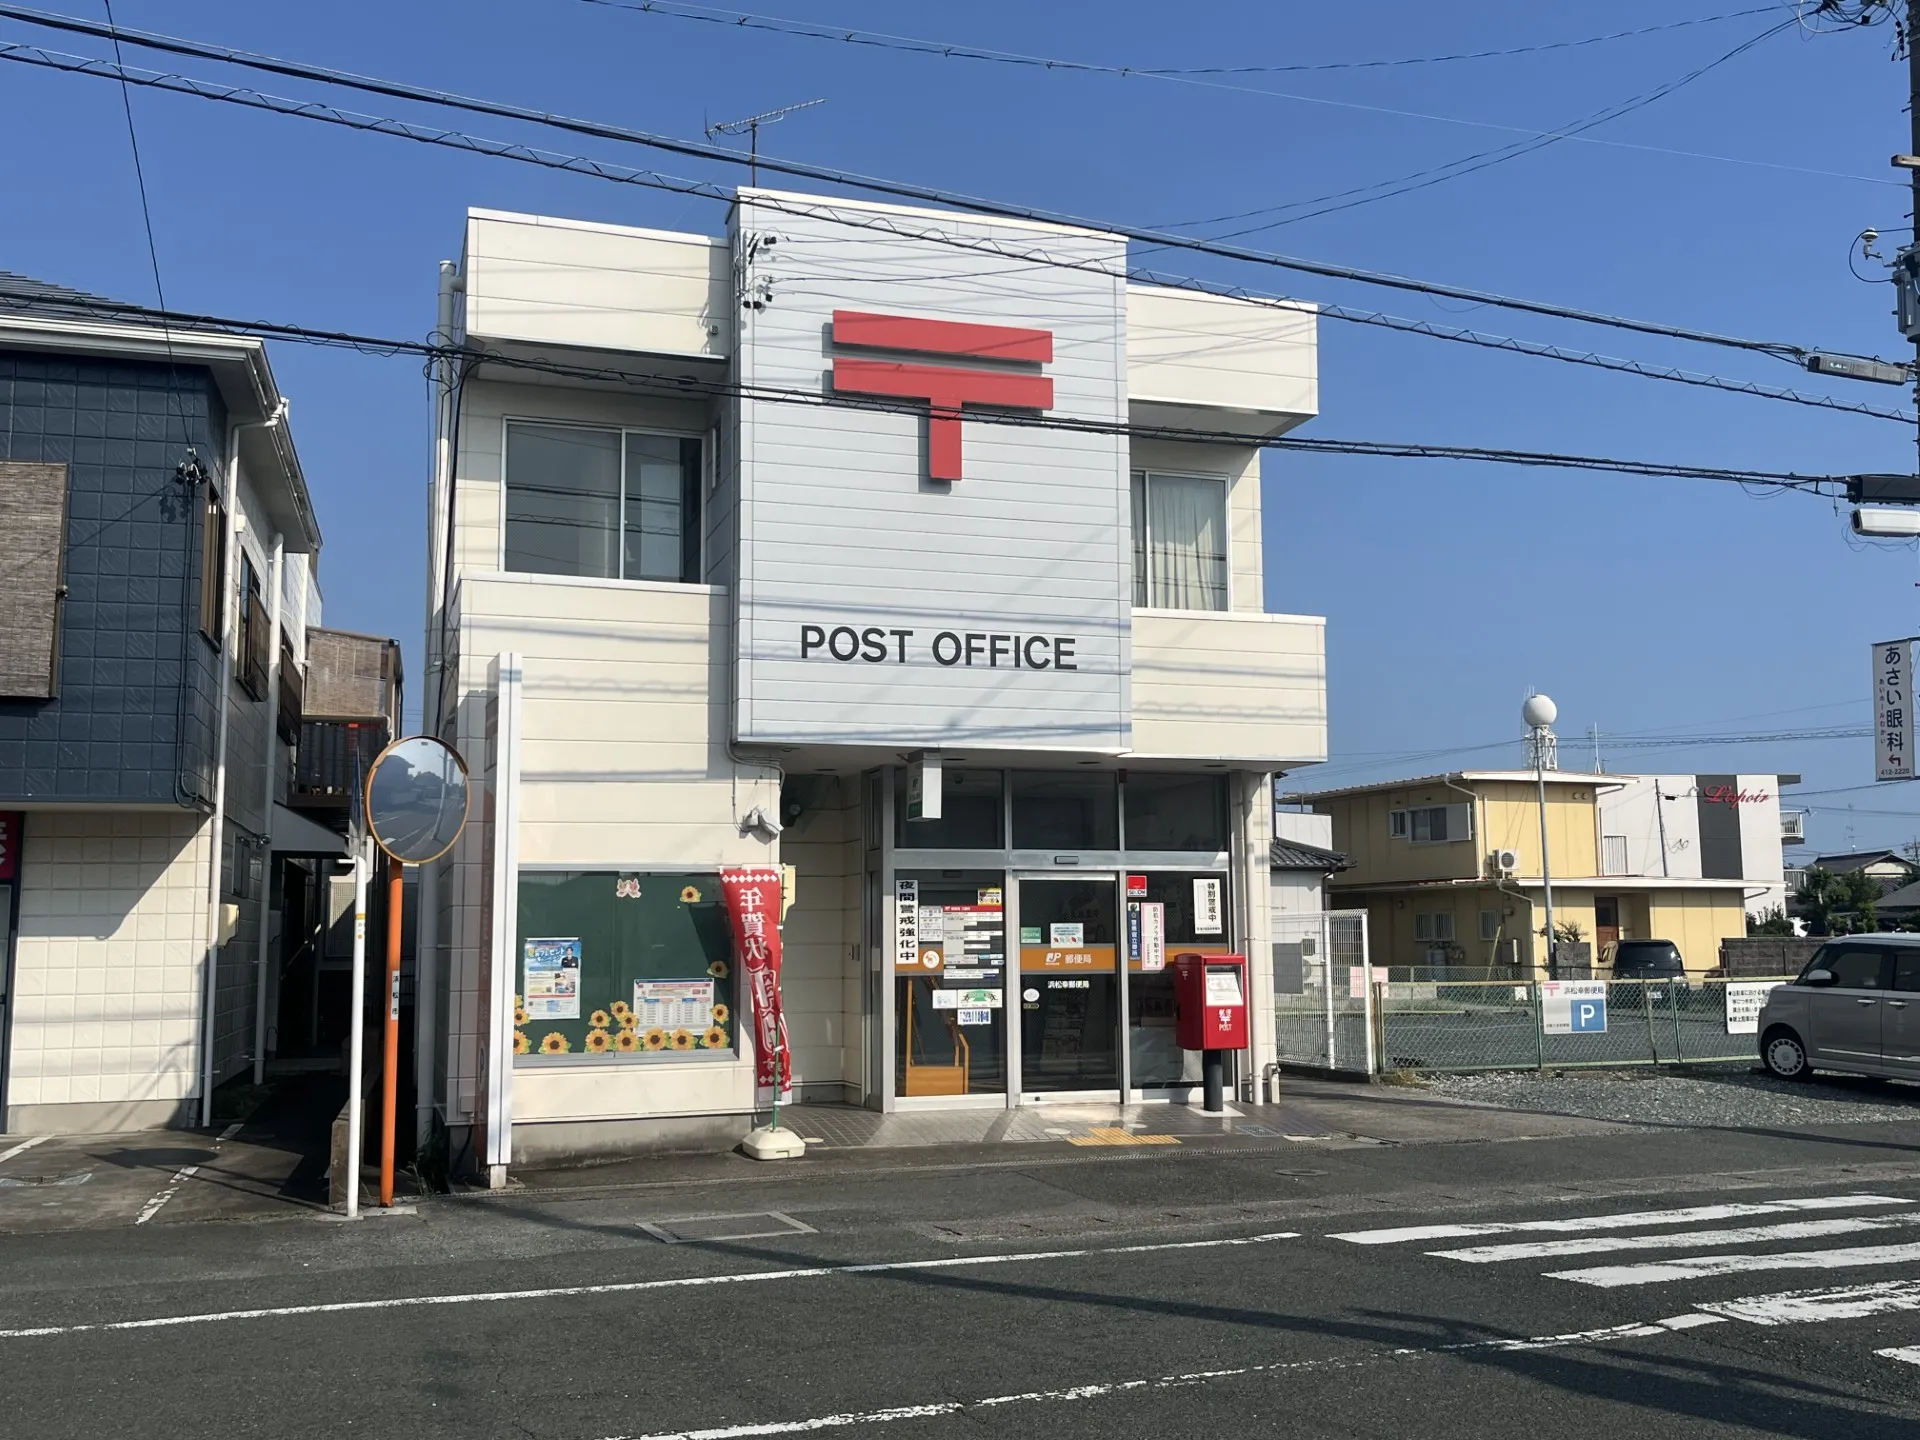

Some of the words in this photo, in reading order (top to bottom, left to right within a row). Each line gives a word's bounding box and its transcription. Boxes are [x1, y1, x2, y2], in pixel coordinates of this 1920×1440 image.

[801, 625, 914, 664] POST
[932, 630, 1078, 670] OFFICE
[1885, 645, 1904, 752] あさい眼科
[1207, 882, 1217, 923] 特別警戒中
[898, 880, 916, 961] 夜間警戒強化中
[1064, 953, 1092, 964] 郵便局
[1047, 980, 1090, 989] 浜松幸郵便局
[1563, 986, 1604, 995] 浜松幸郵便局
[1218, 1023, 1232, 1031] POST
[1580, 1004, 1595, 1028] P
